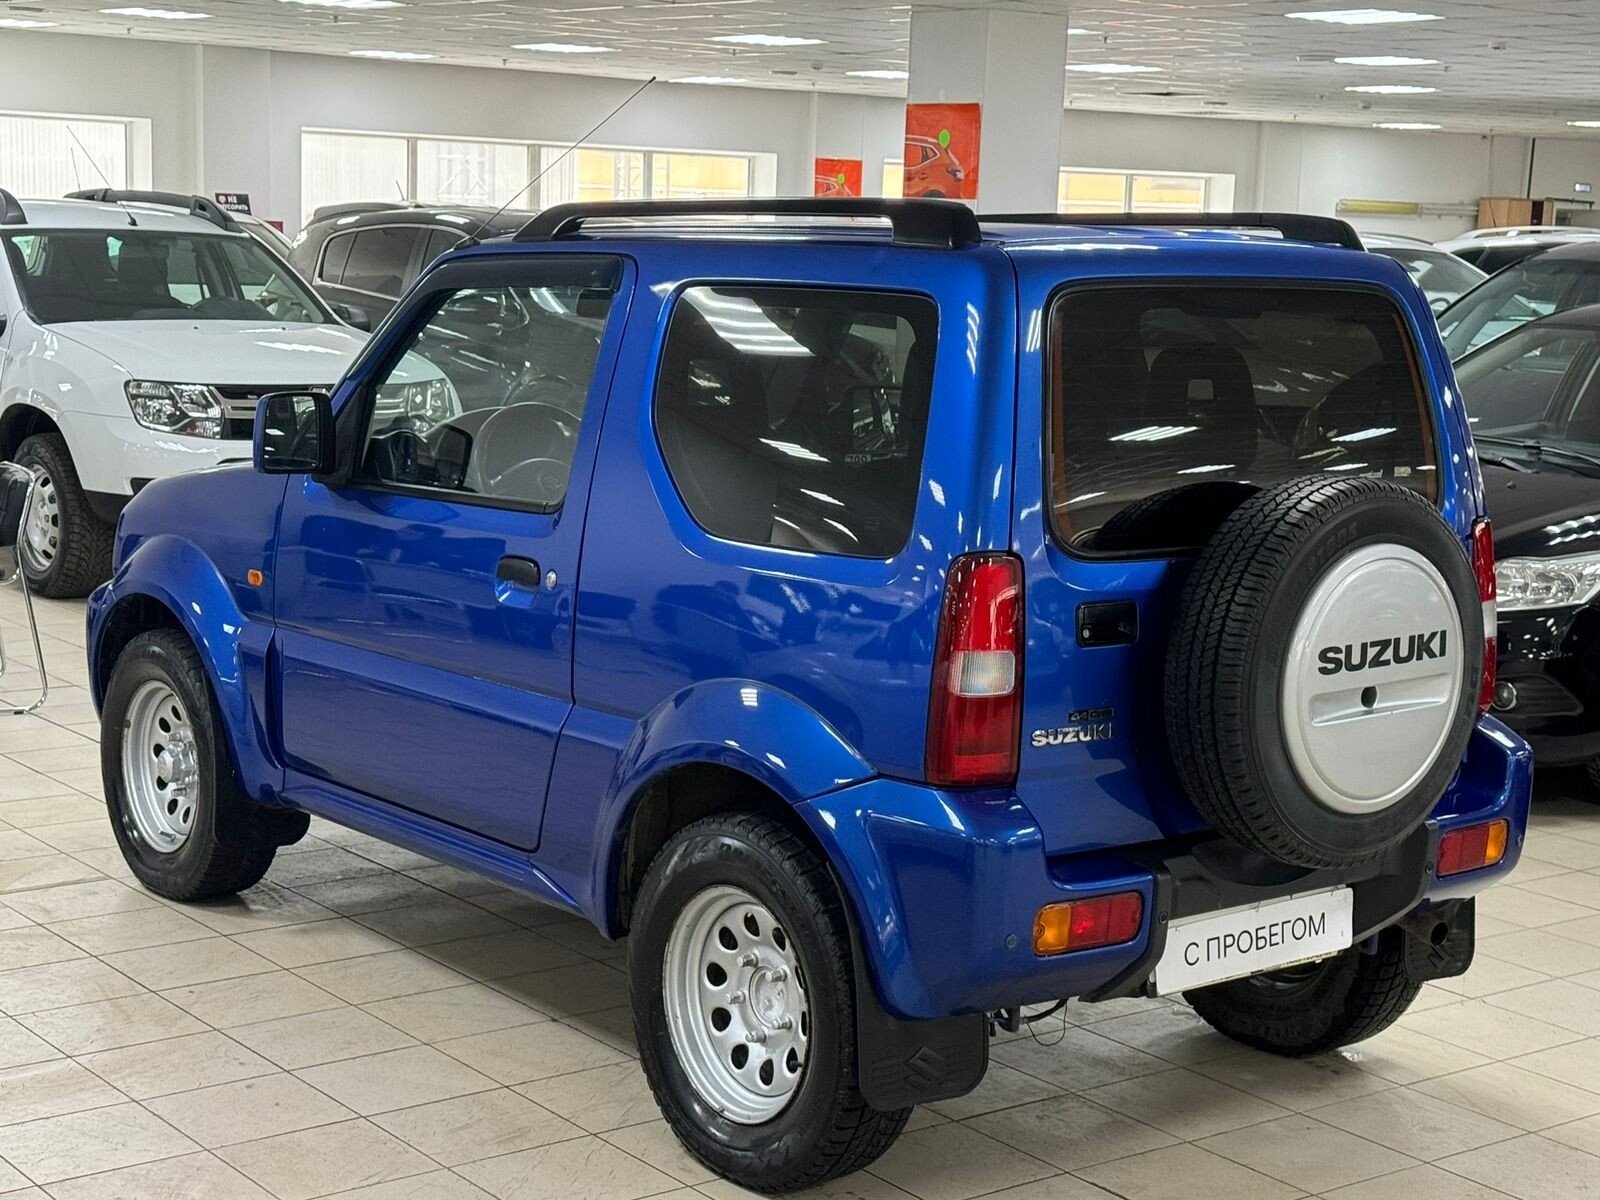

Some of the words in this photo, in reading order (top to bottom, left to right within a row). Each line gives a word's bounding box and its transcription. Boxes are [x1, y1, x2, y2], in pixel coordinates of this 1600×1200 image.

[1318, 629, 1448, 676] SUZUKI
[1031, 721, 1113, 747] SUZUKI
[1184, 941, 1200, 966] С
[1206, 912, 1327, 962] ПРОБЕГОМ
